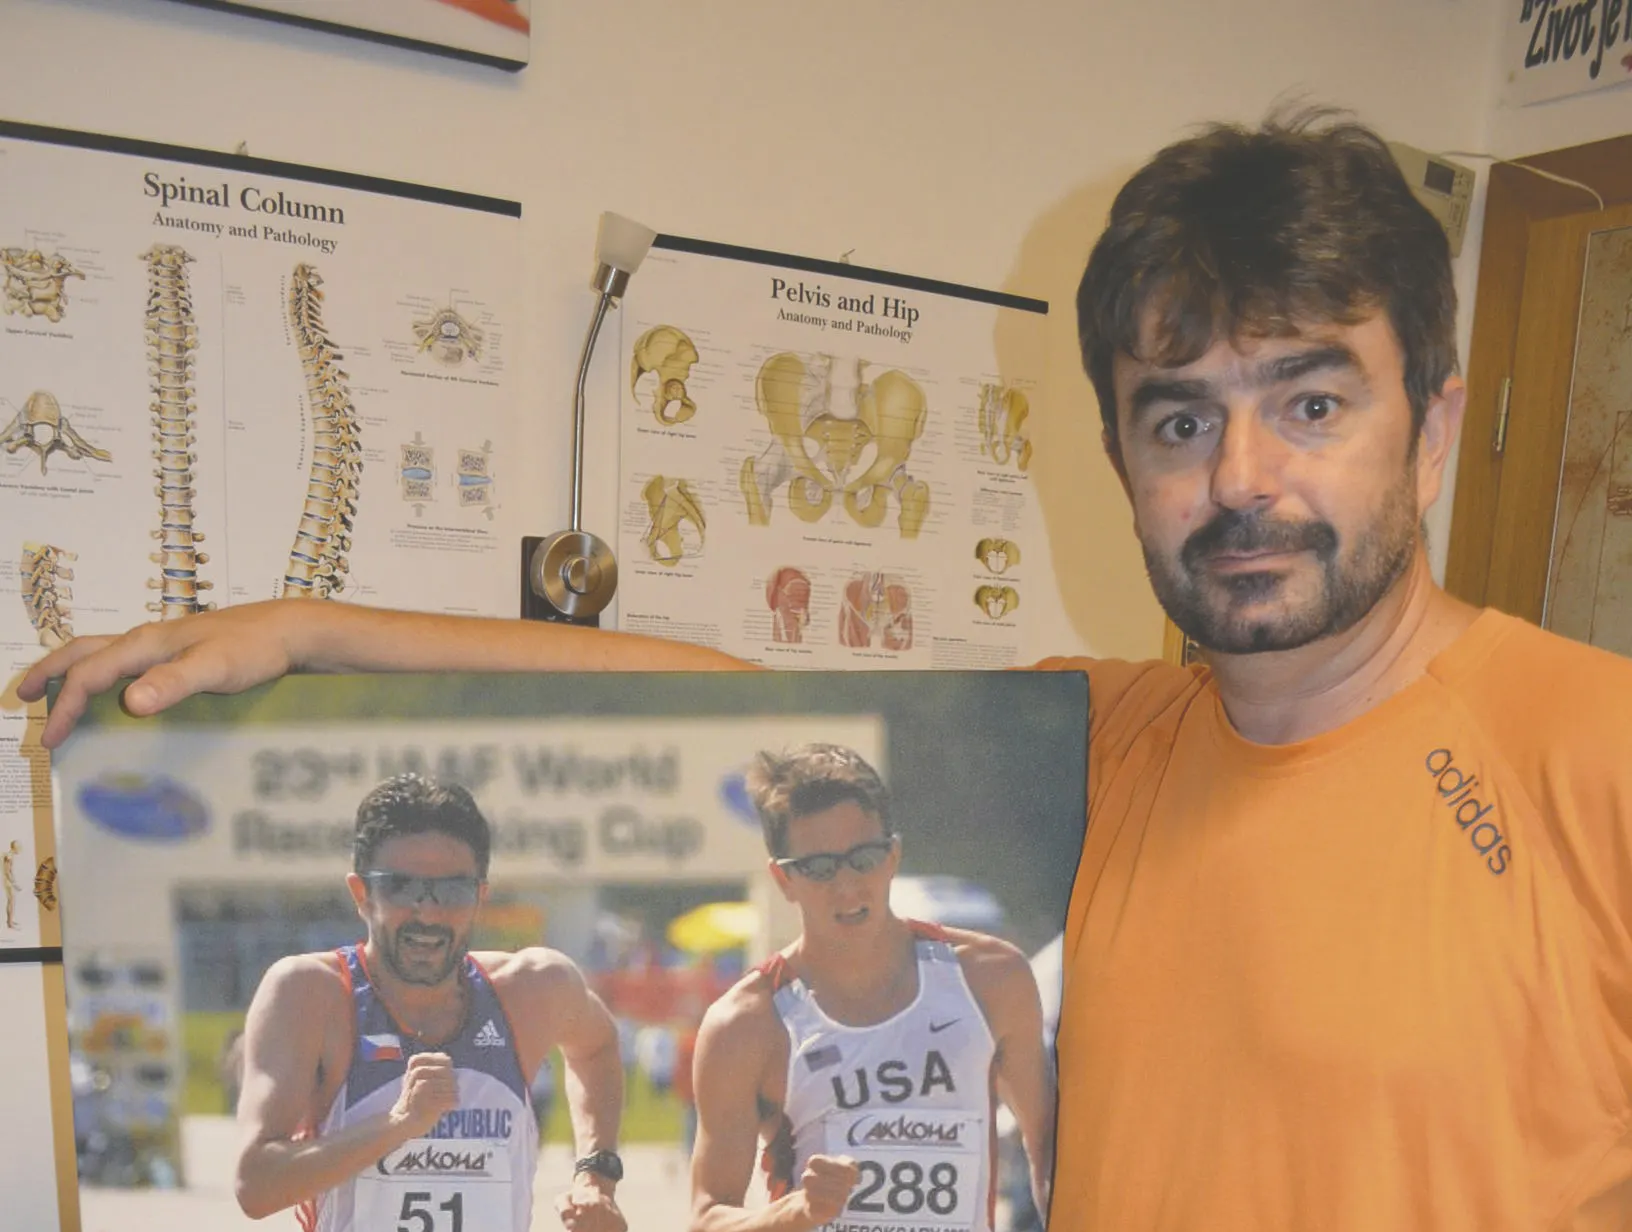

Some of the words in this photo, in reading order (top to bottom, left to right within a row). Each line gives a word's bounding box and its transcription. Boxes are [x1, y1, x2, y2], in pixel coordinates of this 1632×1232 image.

[144, 172, 230, 208] Spinal
[240, 187, 345, 225] Column
[152, 212, 225, 239] Anatomy
[228, 225, 258, 239] and
[263, 226, 338, 255] Pathology
[771, 278, 831, 308] Pelvis
[837, 294, 875, 315] and
[881, 296, 920, 328] Hip
[777, 308, 828, 332] Anatomy
[831, 319, 853, 332] and
[856, 320, 913, 344] Pathology
[1425, 748, 1512, 875] adidas
[831, 1051, 956, 1110] USA
[847, 1160, 958, 1216] 288
